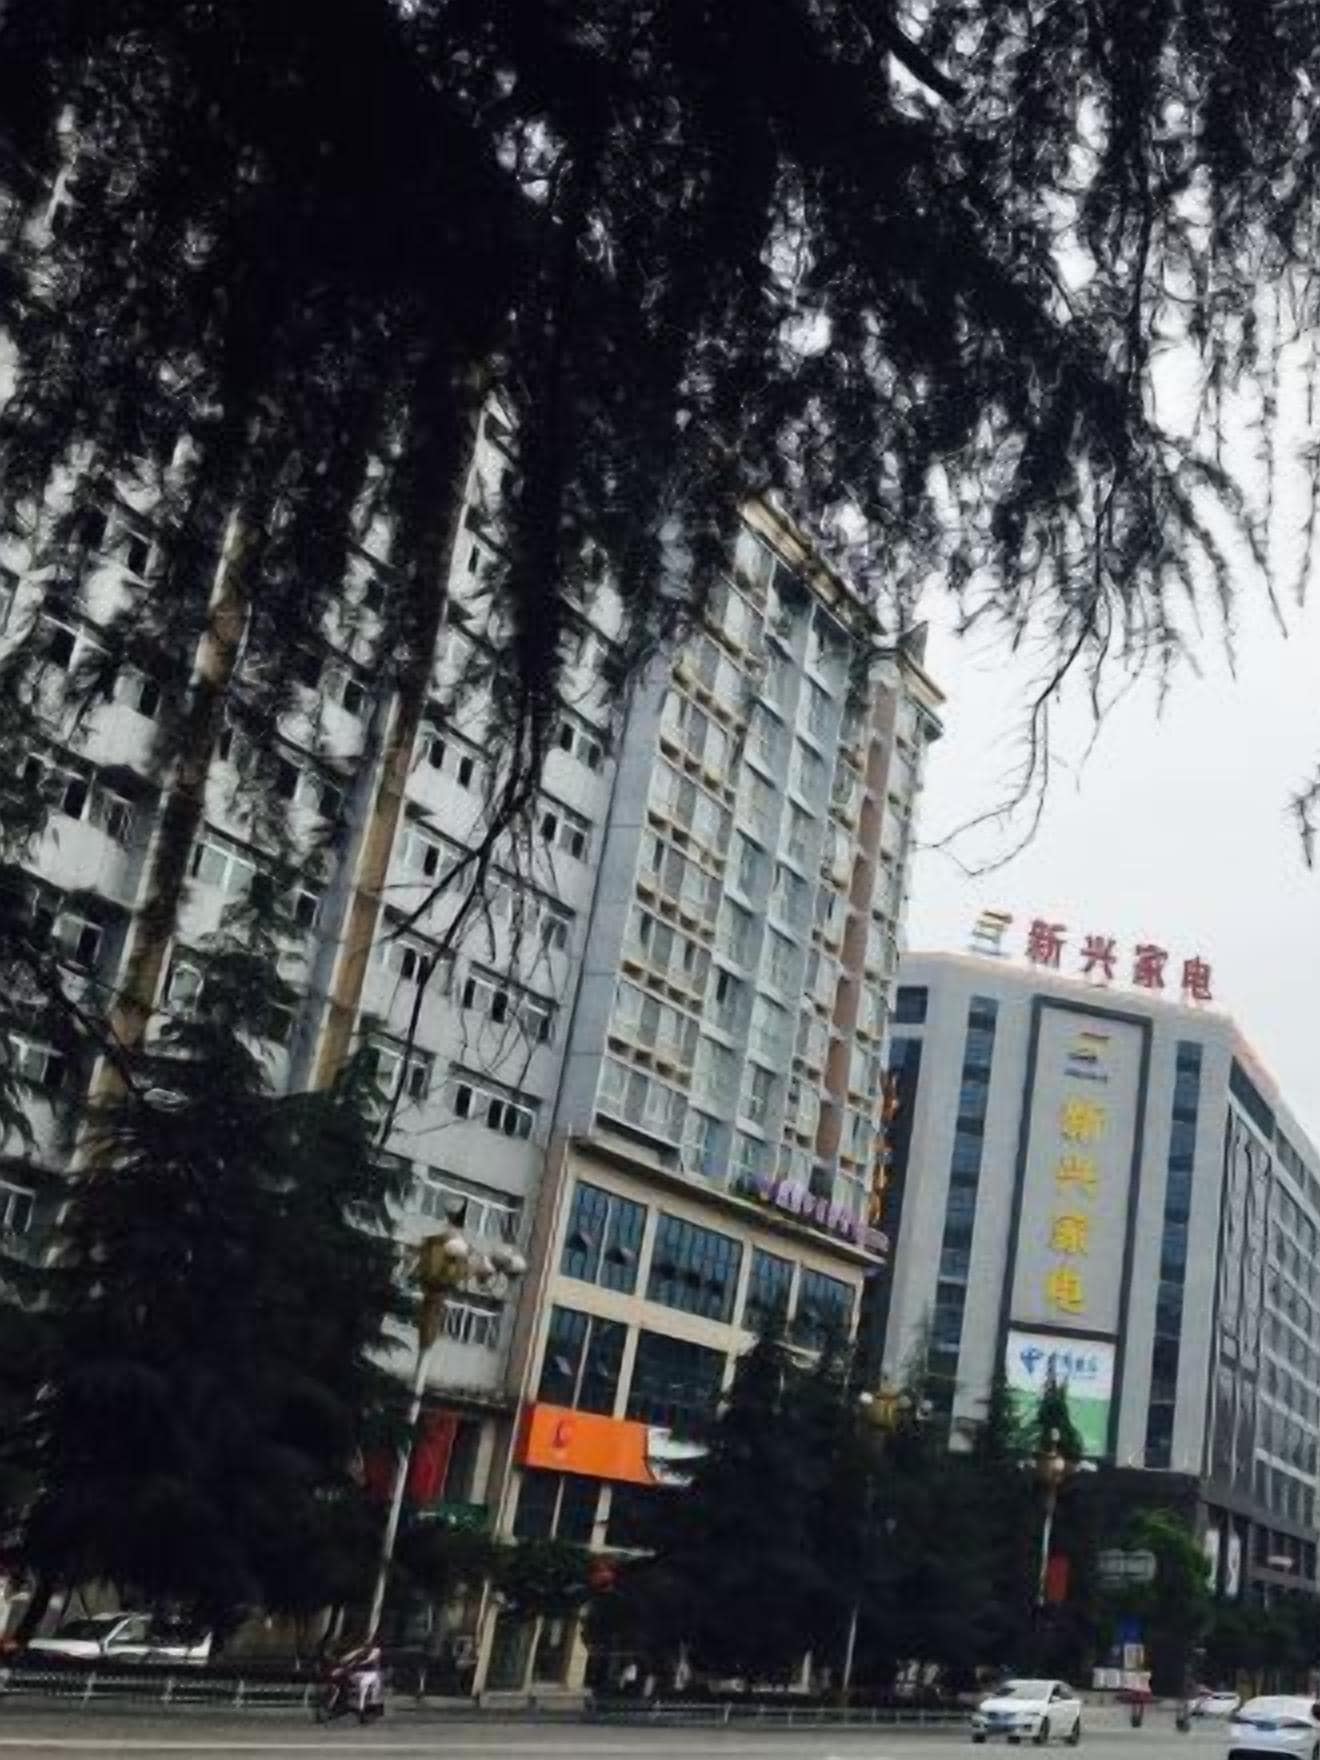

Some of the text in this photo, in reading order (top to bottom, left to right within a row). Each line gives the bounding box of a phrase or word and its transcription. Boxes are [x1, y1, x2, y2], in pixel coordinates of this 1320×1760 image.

[1026, 918, 1212, 1000] 新兴家电
[1047, 1097, 1107, 1316] 新兴家电
